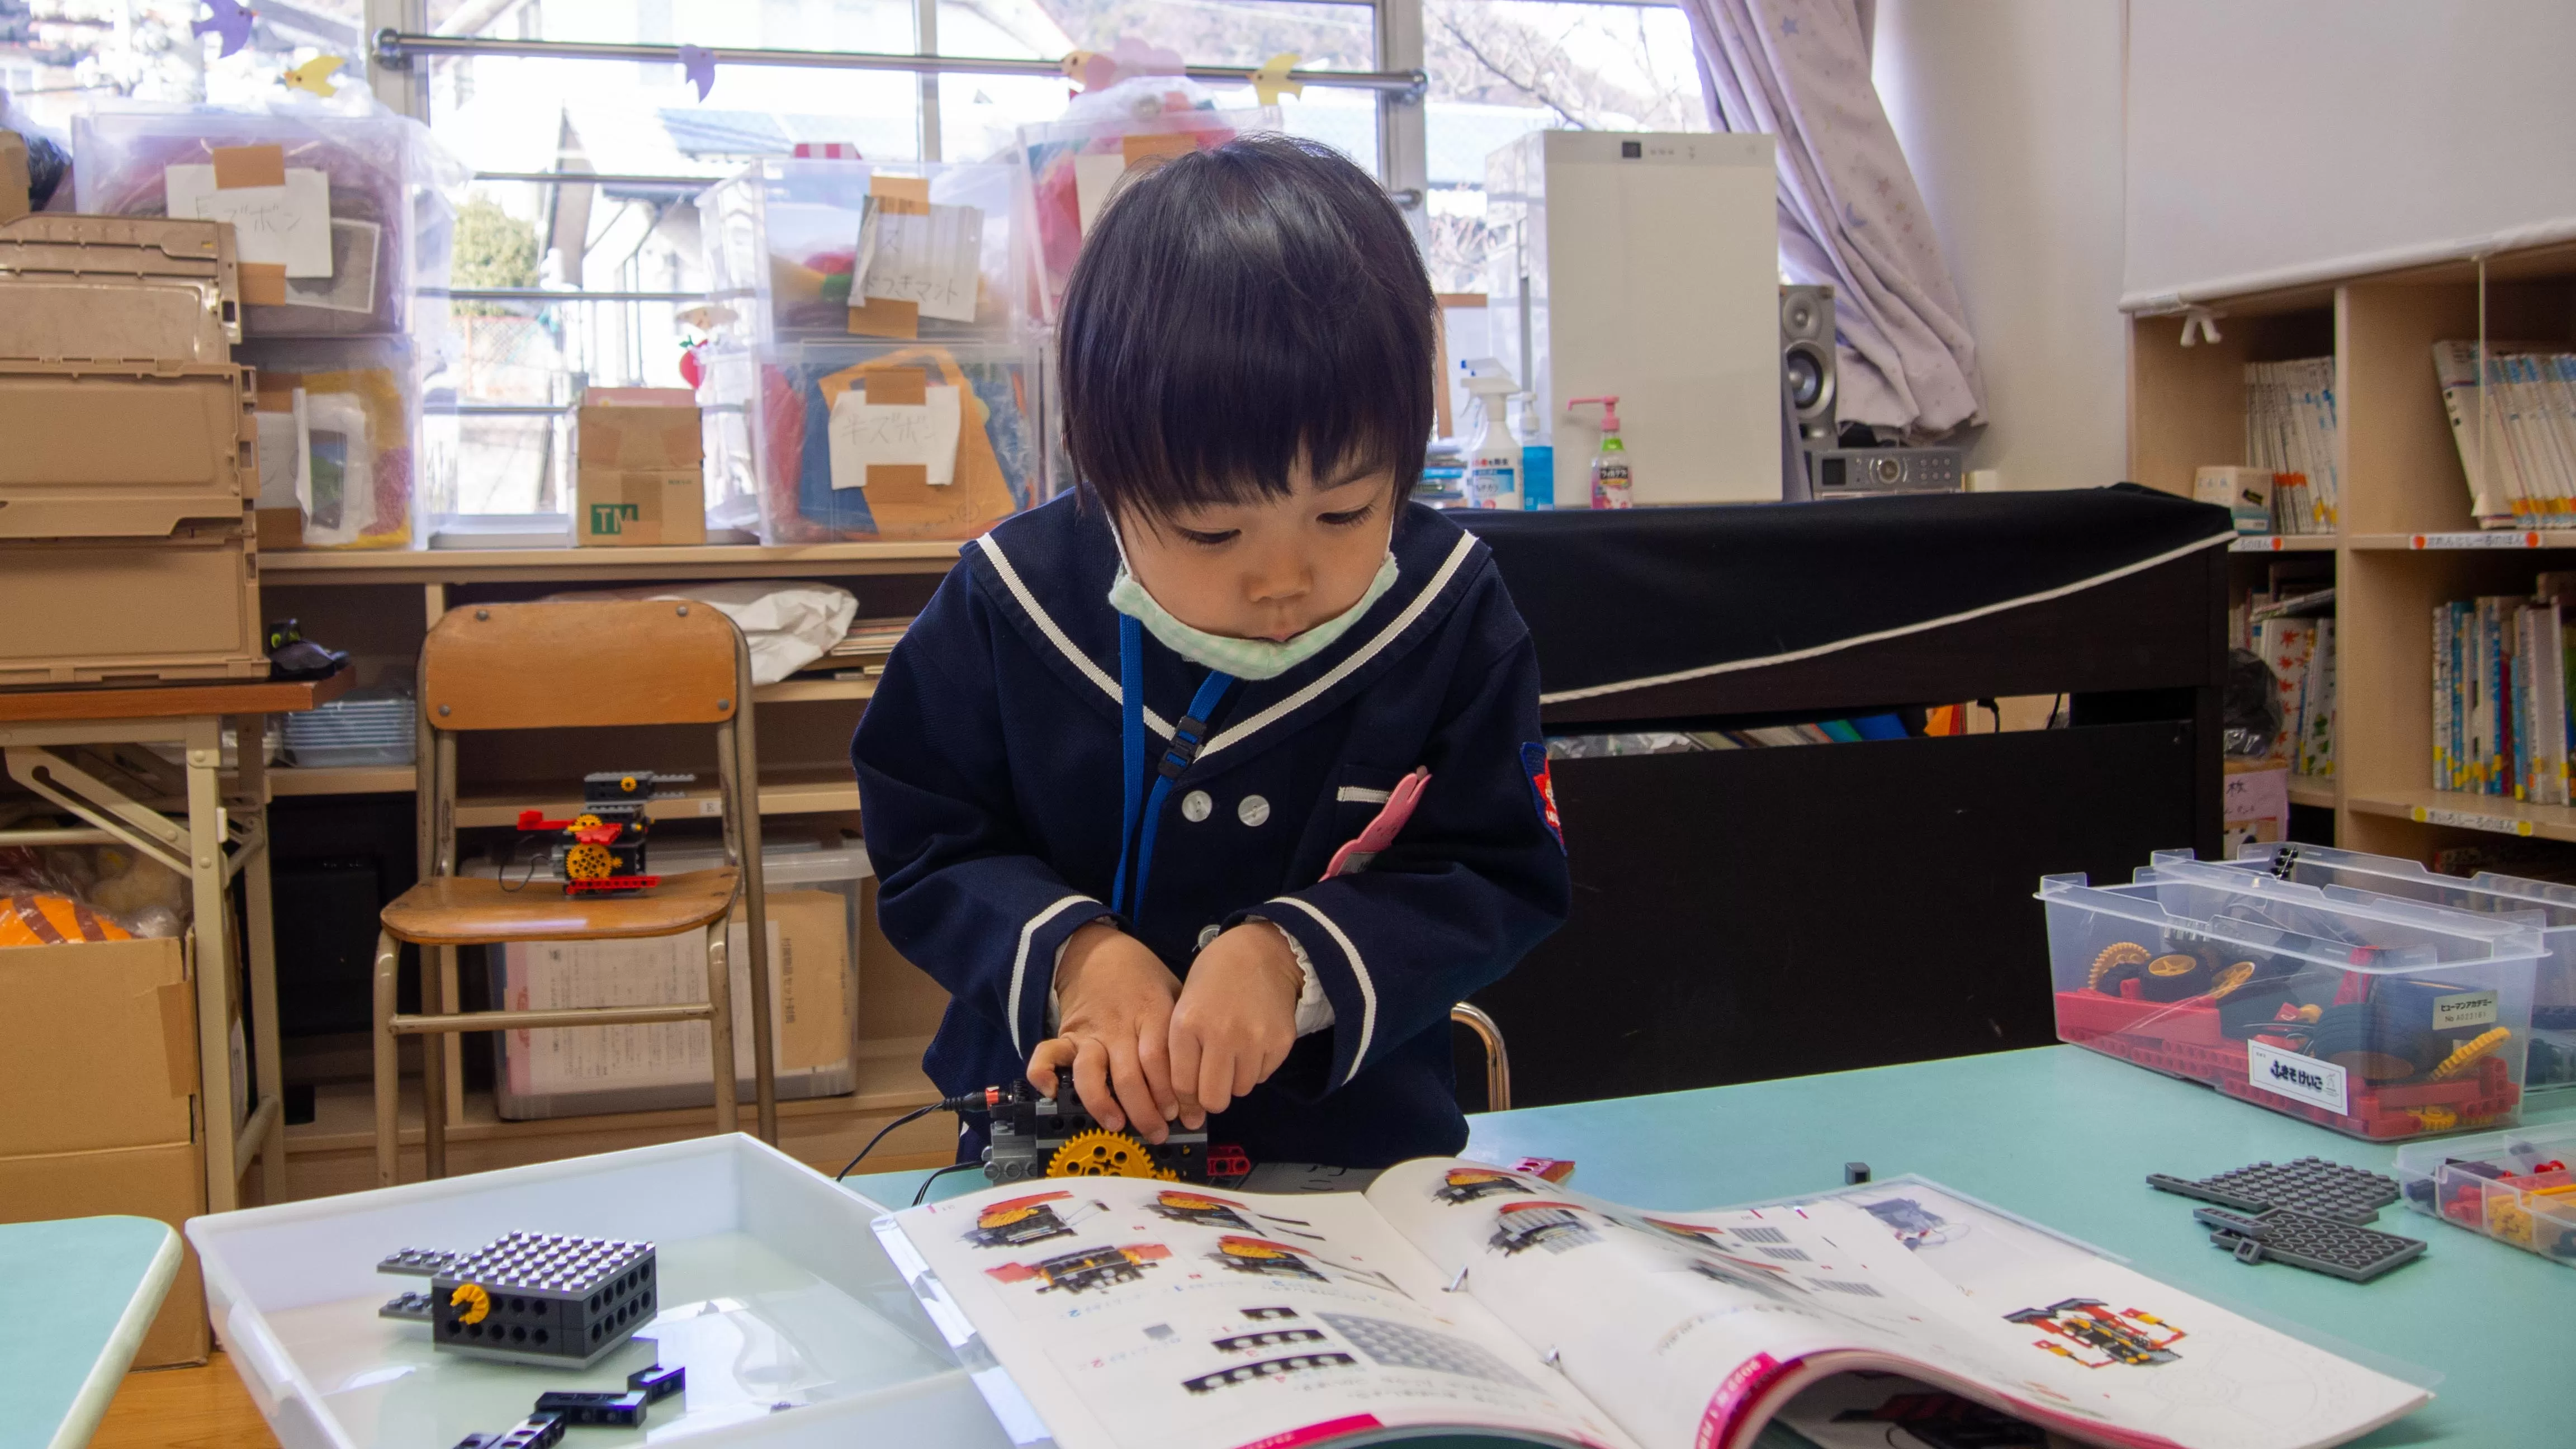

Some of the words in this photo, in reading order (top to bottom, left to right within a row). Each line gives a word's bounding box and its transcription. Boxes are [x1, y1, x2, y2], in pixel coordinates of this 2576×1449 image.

[2441, 999, 2492, 1012] ヒューマンアカデミー
